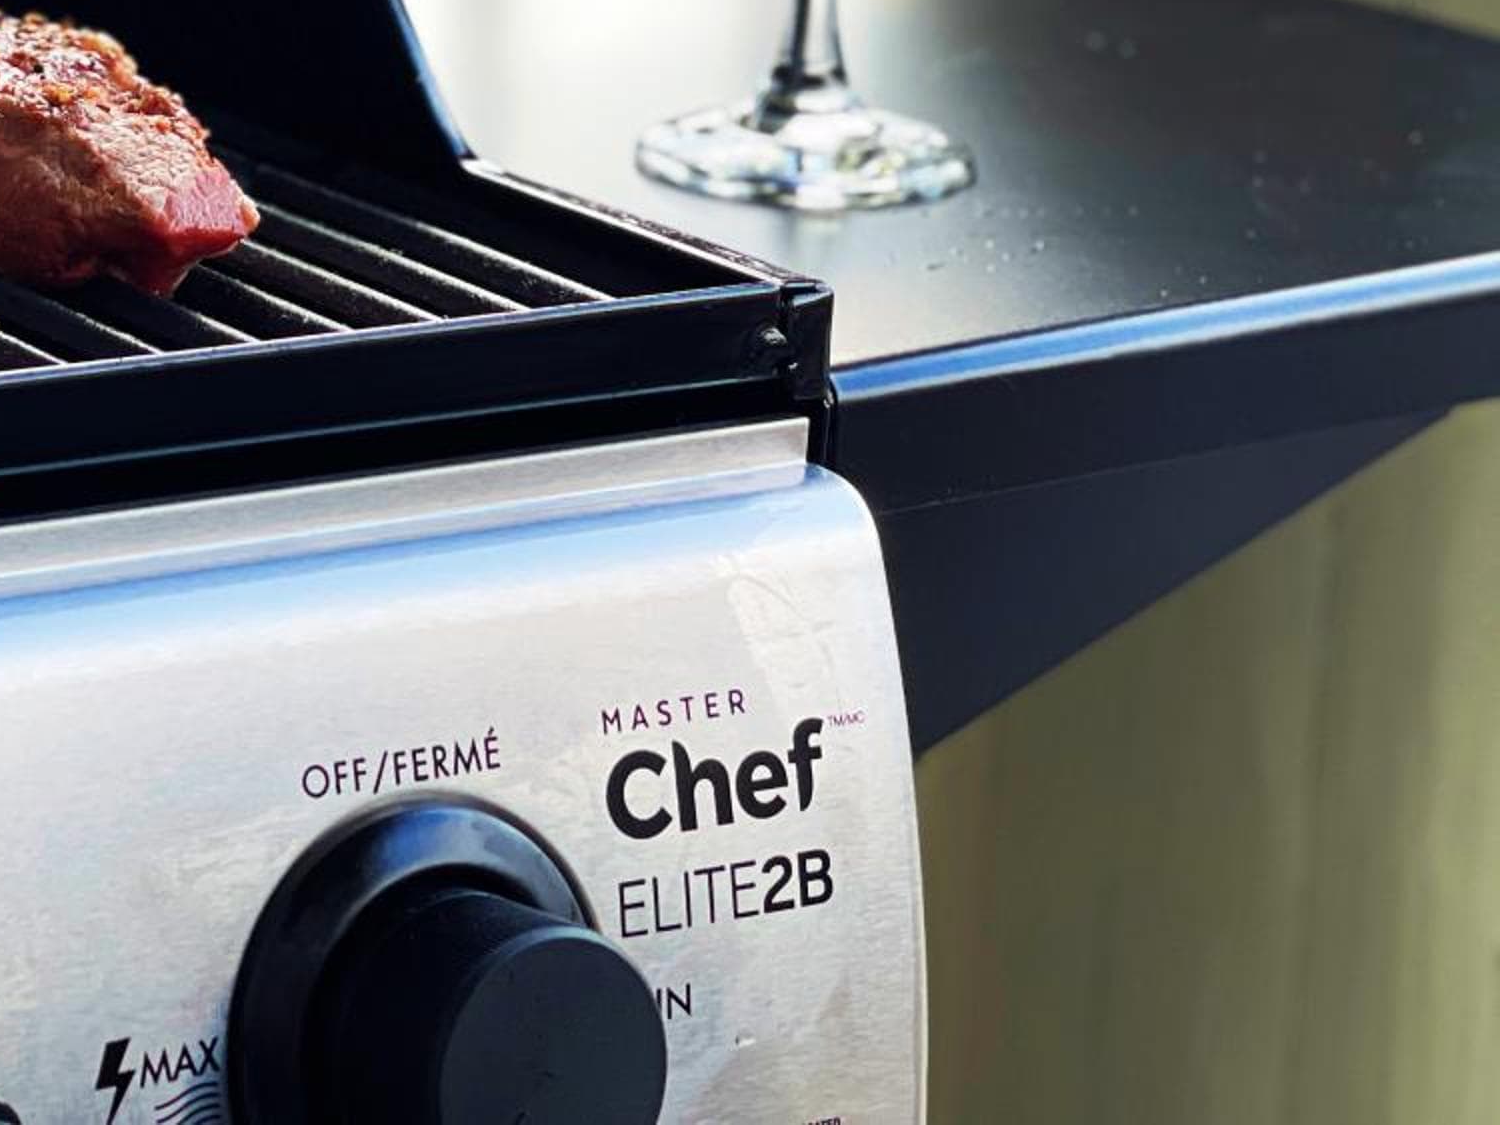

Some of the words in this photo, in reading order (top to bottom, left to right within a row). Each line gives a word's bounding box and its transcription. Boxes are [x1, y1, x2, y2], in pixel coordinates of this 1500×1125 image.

[601, 688, 747, 735] MASTER
[301, 726, 501, 799] OFF/FERMÉ
[606, 717, 824, 840] Chef
[618, 848, 834, 939] ELITE2B
[655, 982, 692, 1020] IN
[139, 1036, 221, 1089] MAX
